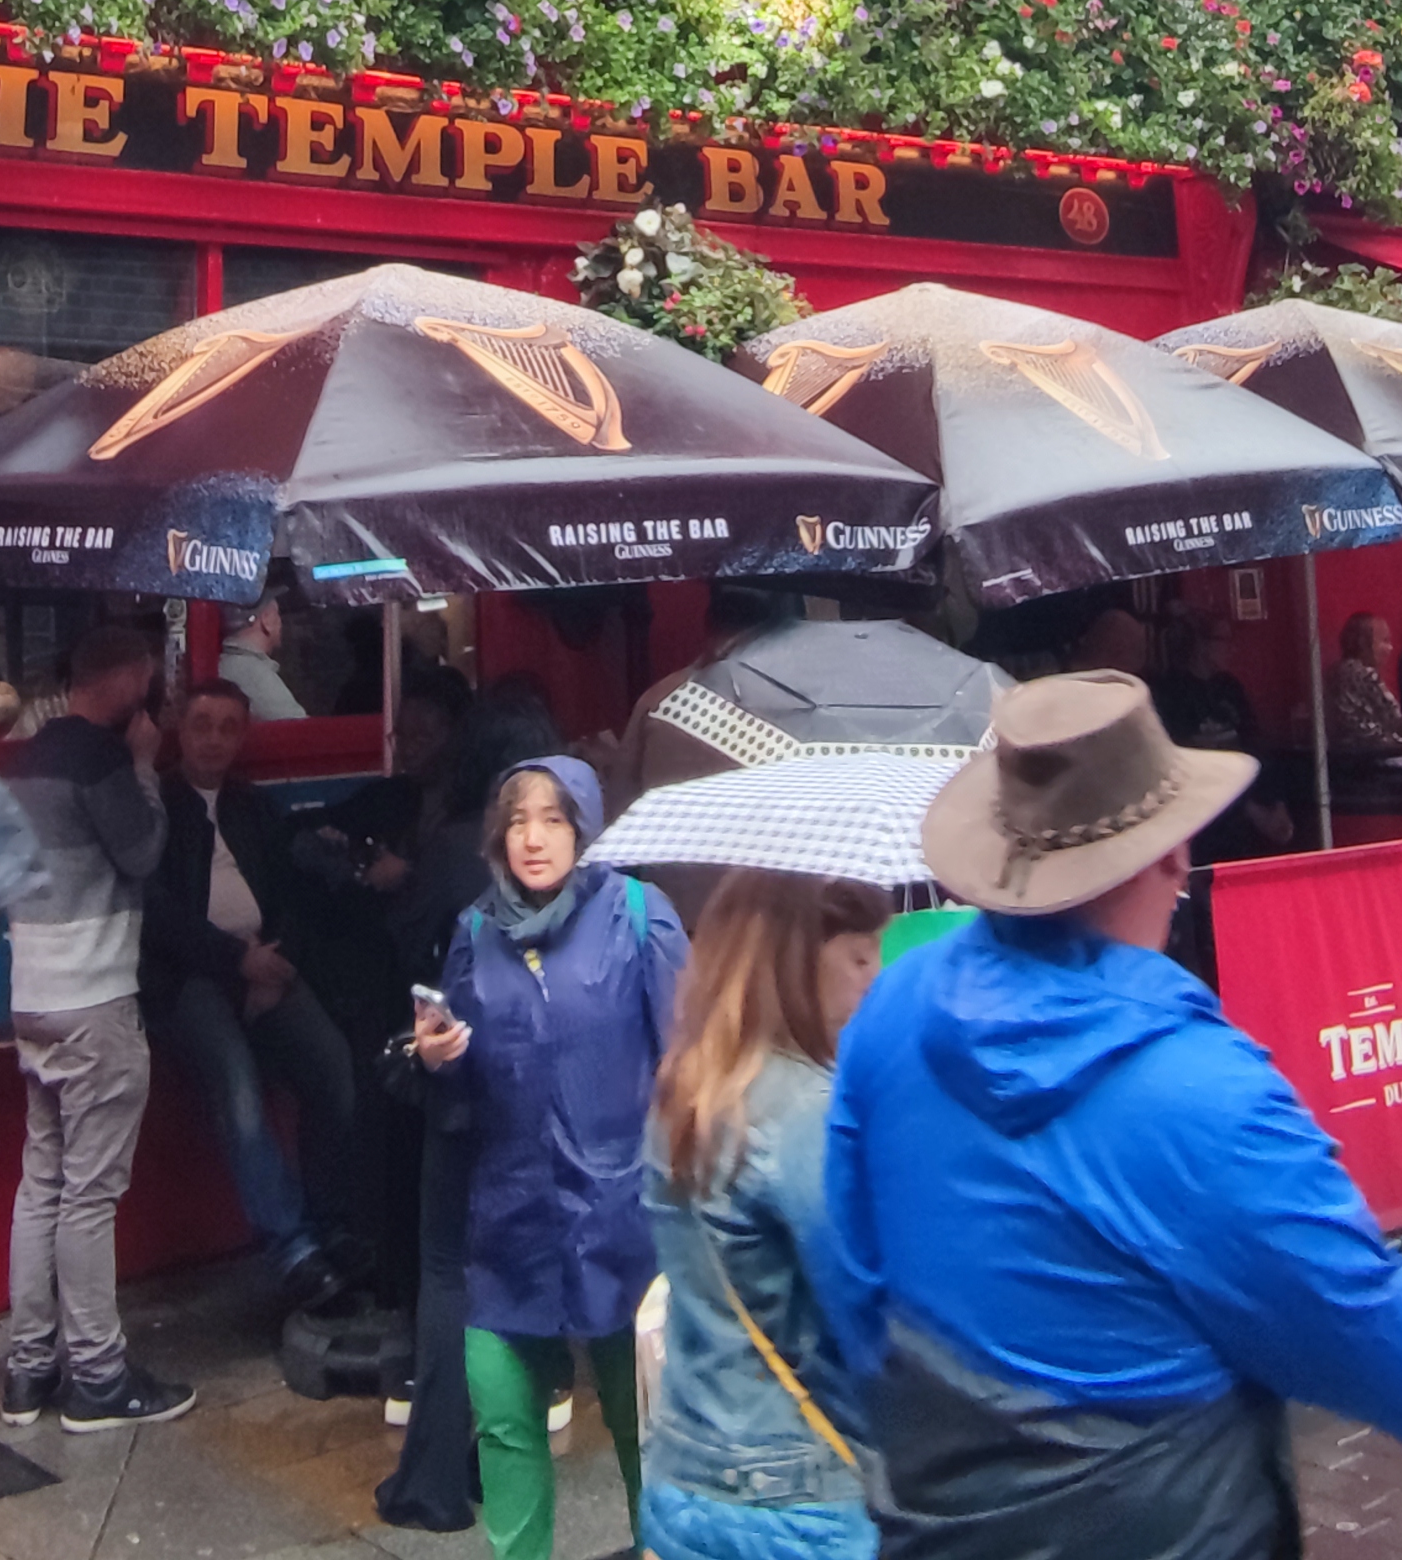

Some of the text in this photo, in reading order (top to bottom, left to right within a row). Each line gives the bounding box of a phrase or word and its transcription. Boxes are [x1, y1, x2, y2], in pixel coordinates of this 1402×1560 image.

[186, 86, 654, 204] TEMPLE
[701, 146, 891, 227] BAR
[1066, 199, 1097, 234] 48
[55, 526, 83, 548] THE
[84, 527, 114, 549] BAR
[549, 517, 730, 547] RAISING THE BAR
[826, 517, 932, 551] GUINNESS
[1125, 511, 1253, 546] RAISING THE BAR
[615, 543, 673, 561] GUINNESS
